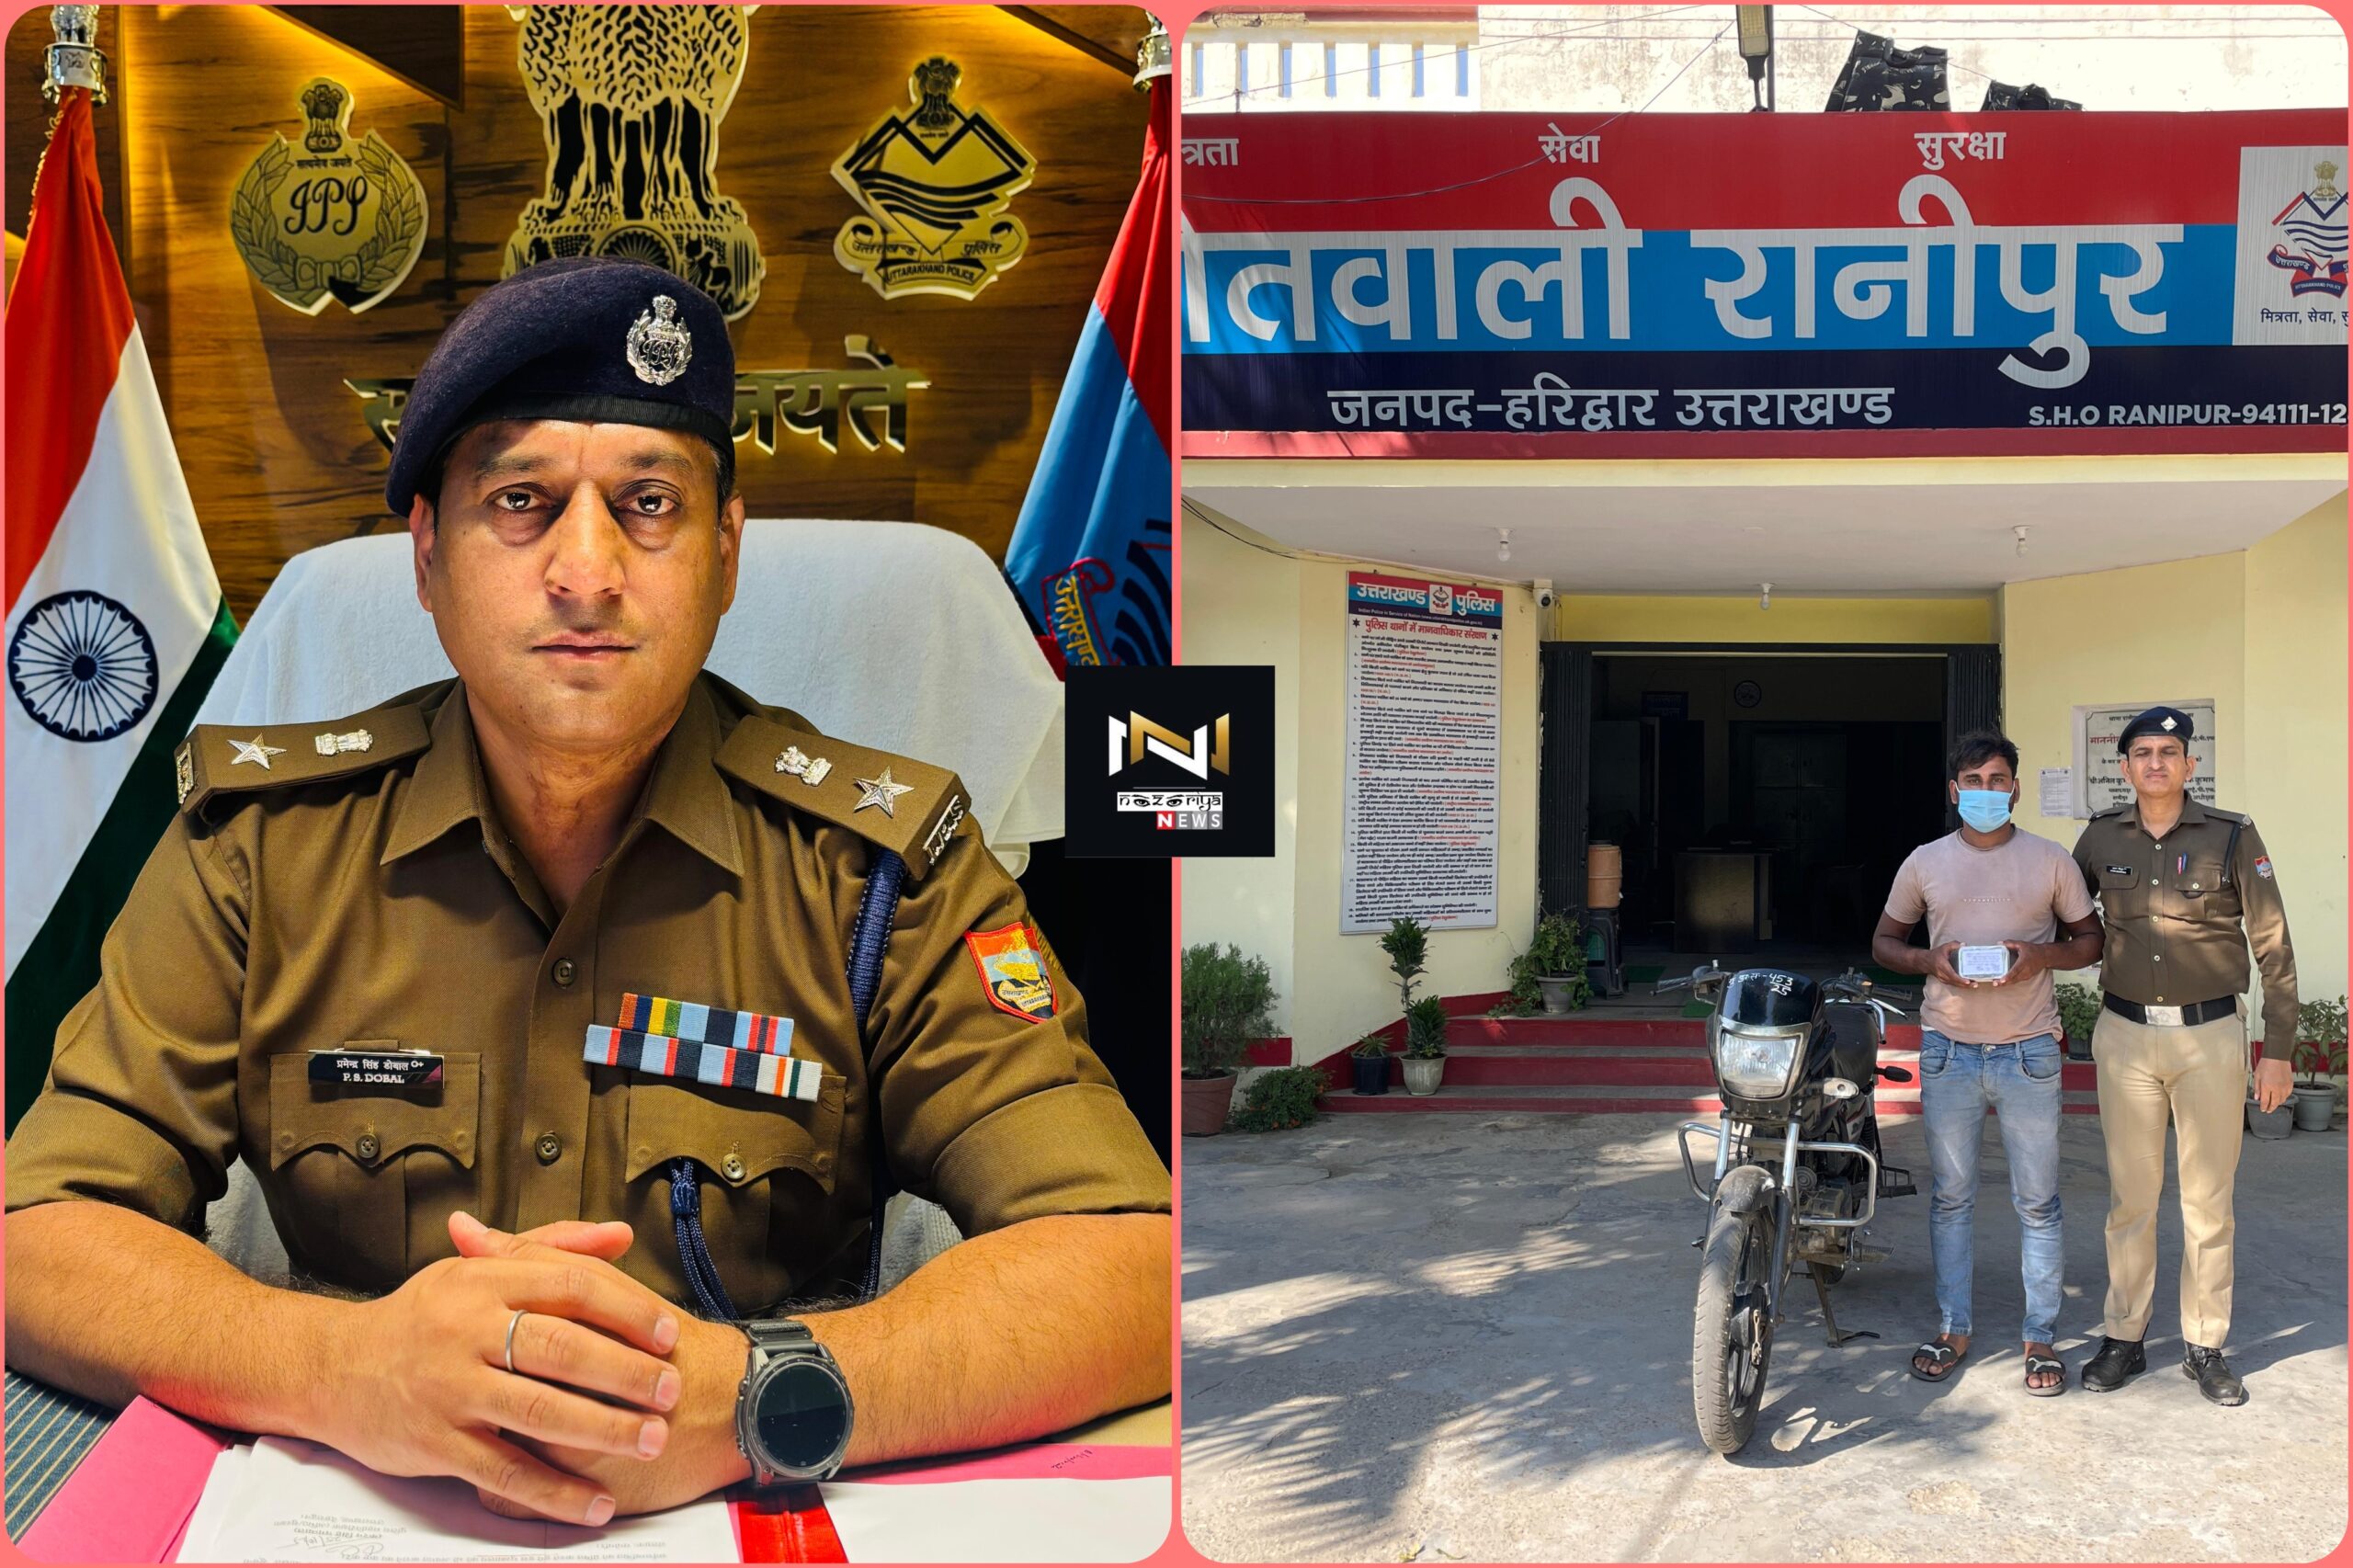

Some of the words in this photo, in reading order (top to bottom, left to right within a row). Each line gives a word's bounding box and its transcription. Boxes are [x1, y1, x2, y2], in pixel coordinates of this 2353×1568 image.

[1539, 122, 1600, 164] सेवा
[1914, 131, 2006, 169] सुरक्षा
[961, 239, 1003, 257] पुलिस
[946, 265, 975, 280] POLICE
[1690, 175, 2184, 389] रानीपुर
[2260, 308, 2302, 324] मित्रता,
[2308, 307, 2336, 324] सेवा,
[1674, 387, 1894, 426] उत्तराखण्ड
[2029, 405, 2100, 426] S.H.O
[1357, 582, 1427, 606] उत्तराखण्ड
[1456, 590, 1496, 616] पुलिस
[1366, 618, 1388, 632] पुलिस
[1418, 624, 1463, 638] मानवाधिकार
[362, 1059, 379, 1070] सिंह
[365, 1074, 404, 1084] DOBAL
